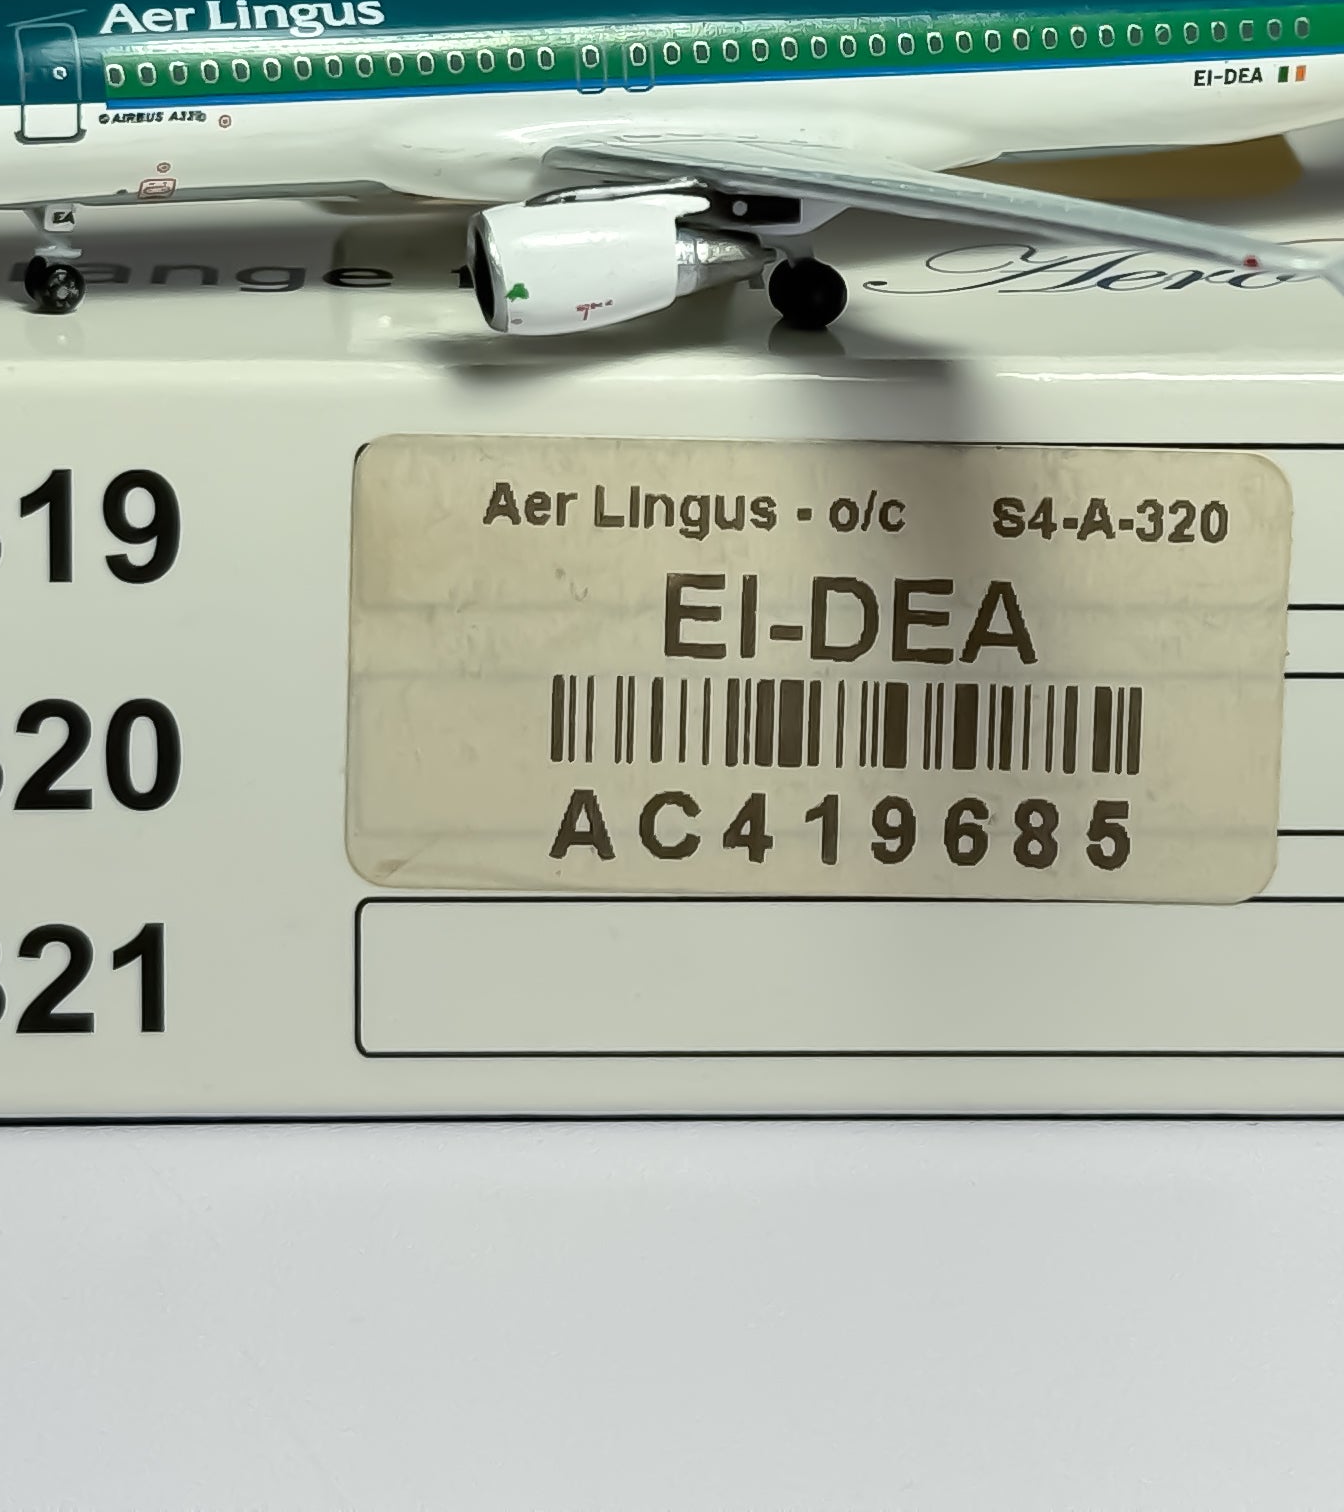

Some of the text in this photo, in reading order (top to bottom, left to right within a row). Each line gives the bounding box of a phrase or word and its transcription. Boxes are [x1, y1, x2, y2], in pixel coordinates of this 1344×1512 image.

[99, 0, 385, 38] Aer Lingus
[1193, 66, 1264, 87] EI-DEA
[111, 111, 164, 124] AIRBUS
[52, 210, 75, 225] EA
[862, 243, 1322, 295] Aero
[482, 482, 578, 527] Aer
[828, 489, 907, 533] o/c
[992, 496, 1231, 545] S4-A-320
[663, 573, 1039, 666] EI-DEA
[549, 789, 1133, 871] AC419685
